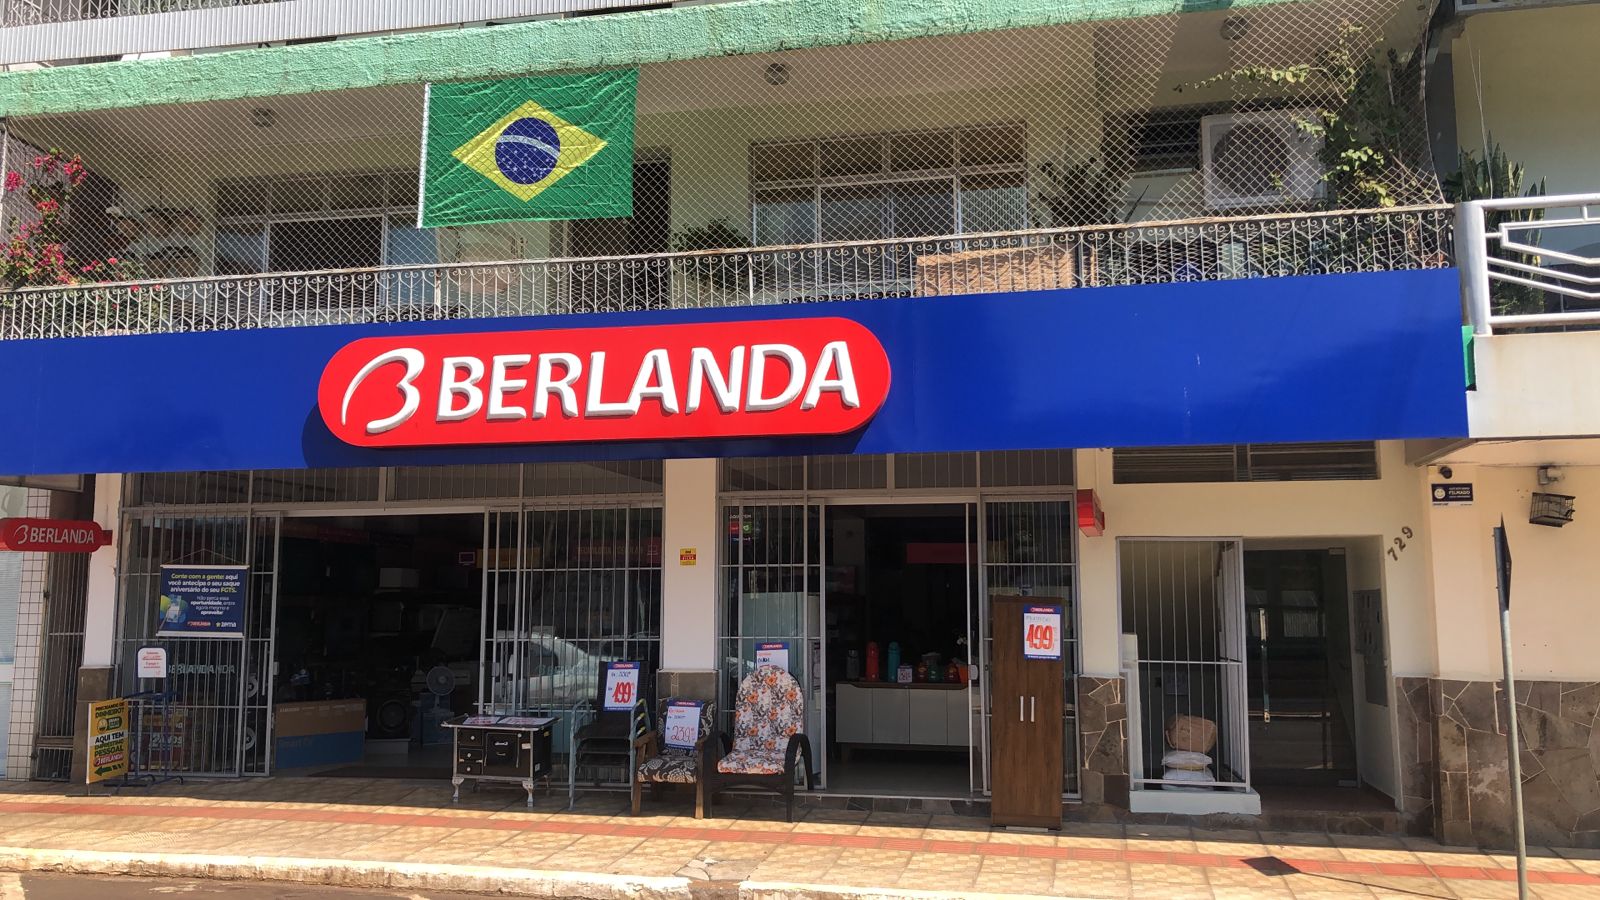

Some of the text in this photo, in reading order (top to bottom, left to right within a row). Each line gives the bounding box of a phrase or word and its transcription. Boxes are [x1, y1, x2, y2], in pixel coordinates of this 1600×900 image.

[435, 340, 861, 421] BERLANDA
[30, 527, 95, 544] BERLANDA
[1387, 526, 1413, 561] 729
[95, 732, 124, 744] AQUI TEM
[94, 746, 124, 758] PESSOAL
